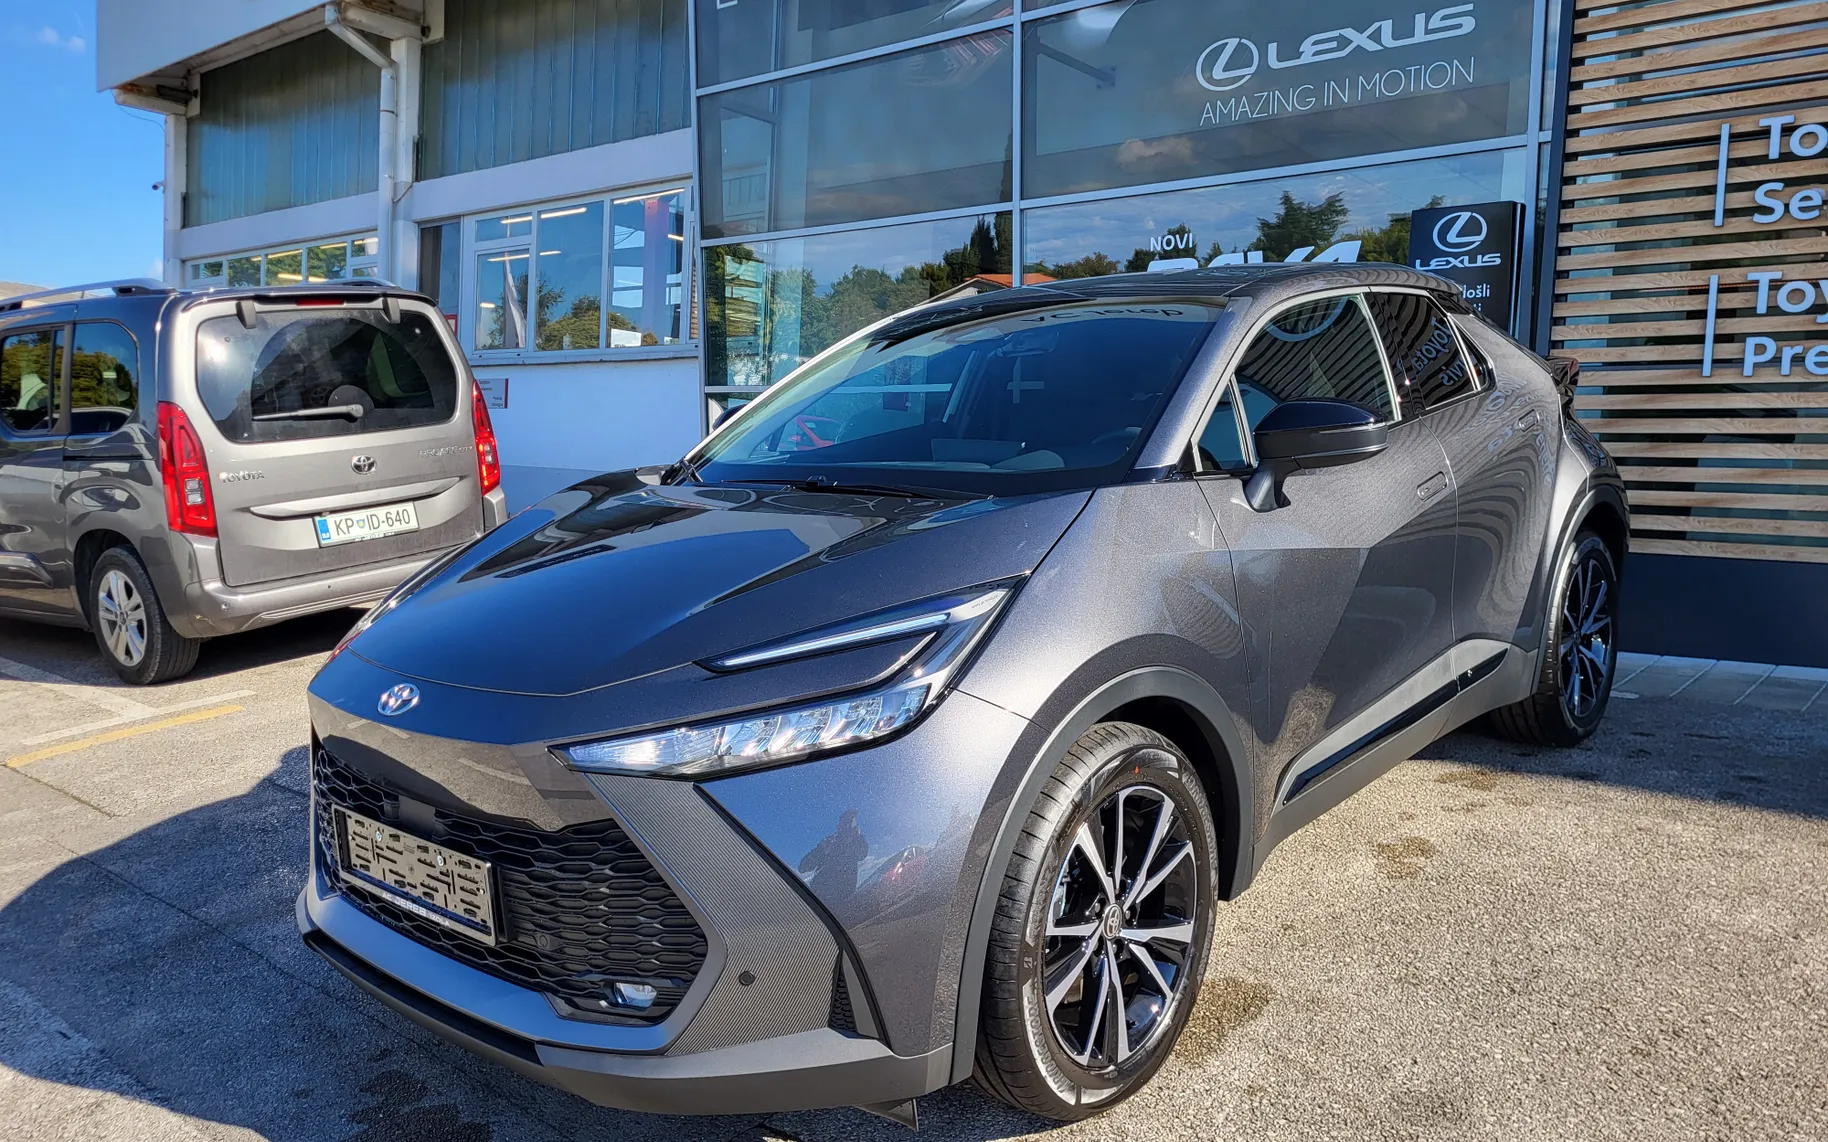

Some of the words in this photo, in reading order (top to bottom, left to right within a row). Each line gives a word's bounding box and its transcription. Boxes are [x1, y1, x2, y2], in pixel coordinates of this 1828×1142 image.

[1267, 3, 1476, 70] LEXUS
[1199, 84, 1316, 127] AMAZING
[1323, 77, 1349, 107] IN
[1357, 56, 1475, 101] MOTION
[1758, 114, 1828, 160] To
[1752, 181, 1823, 224] Se
[1149, 232, 1194, 252] NOVI
[1415, 252, 1502, 271] LEXUS
[1742, 335, 1828, 378] Pre
[218, 470, 265, 484] TOYOTA
[333, 517, 355, 536] KP
[366, 508, 411, 531] ID-640
